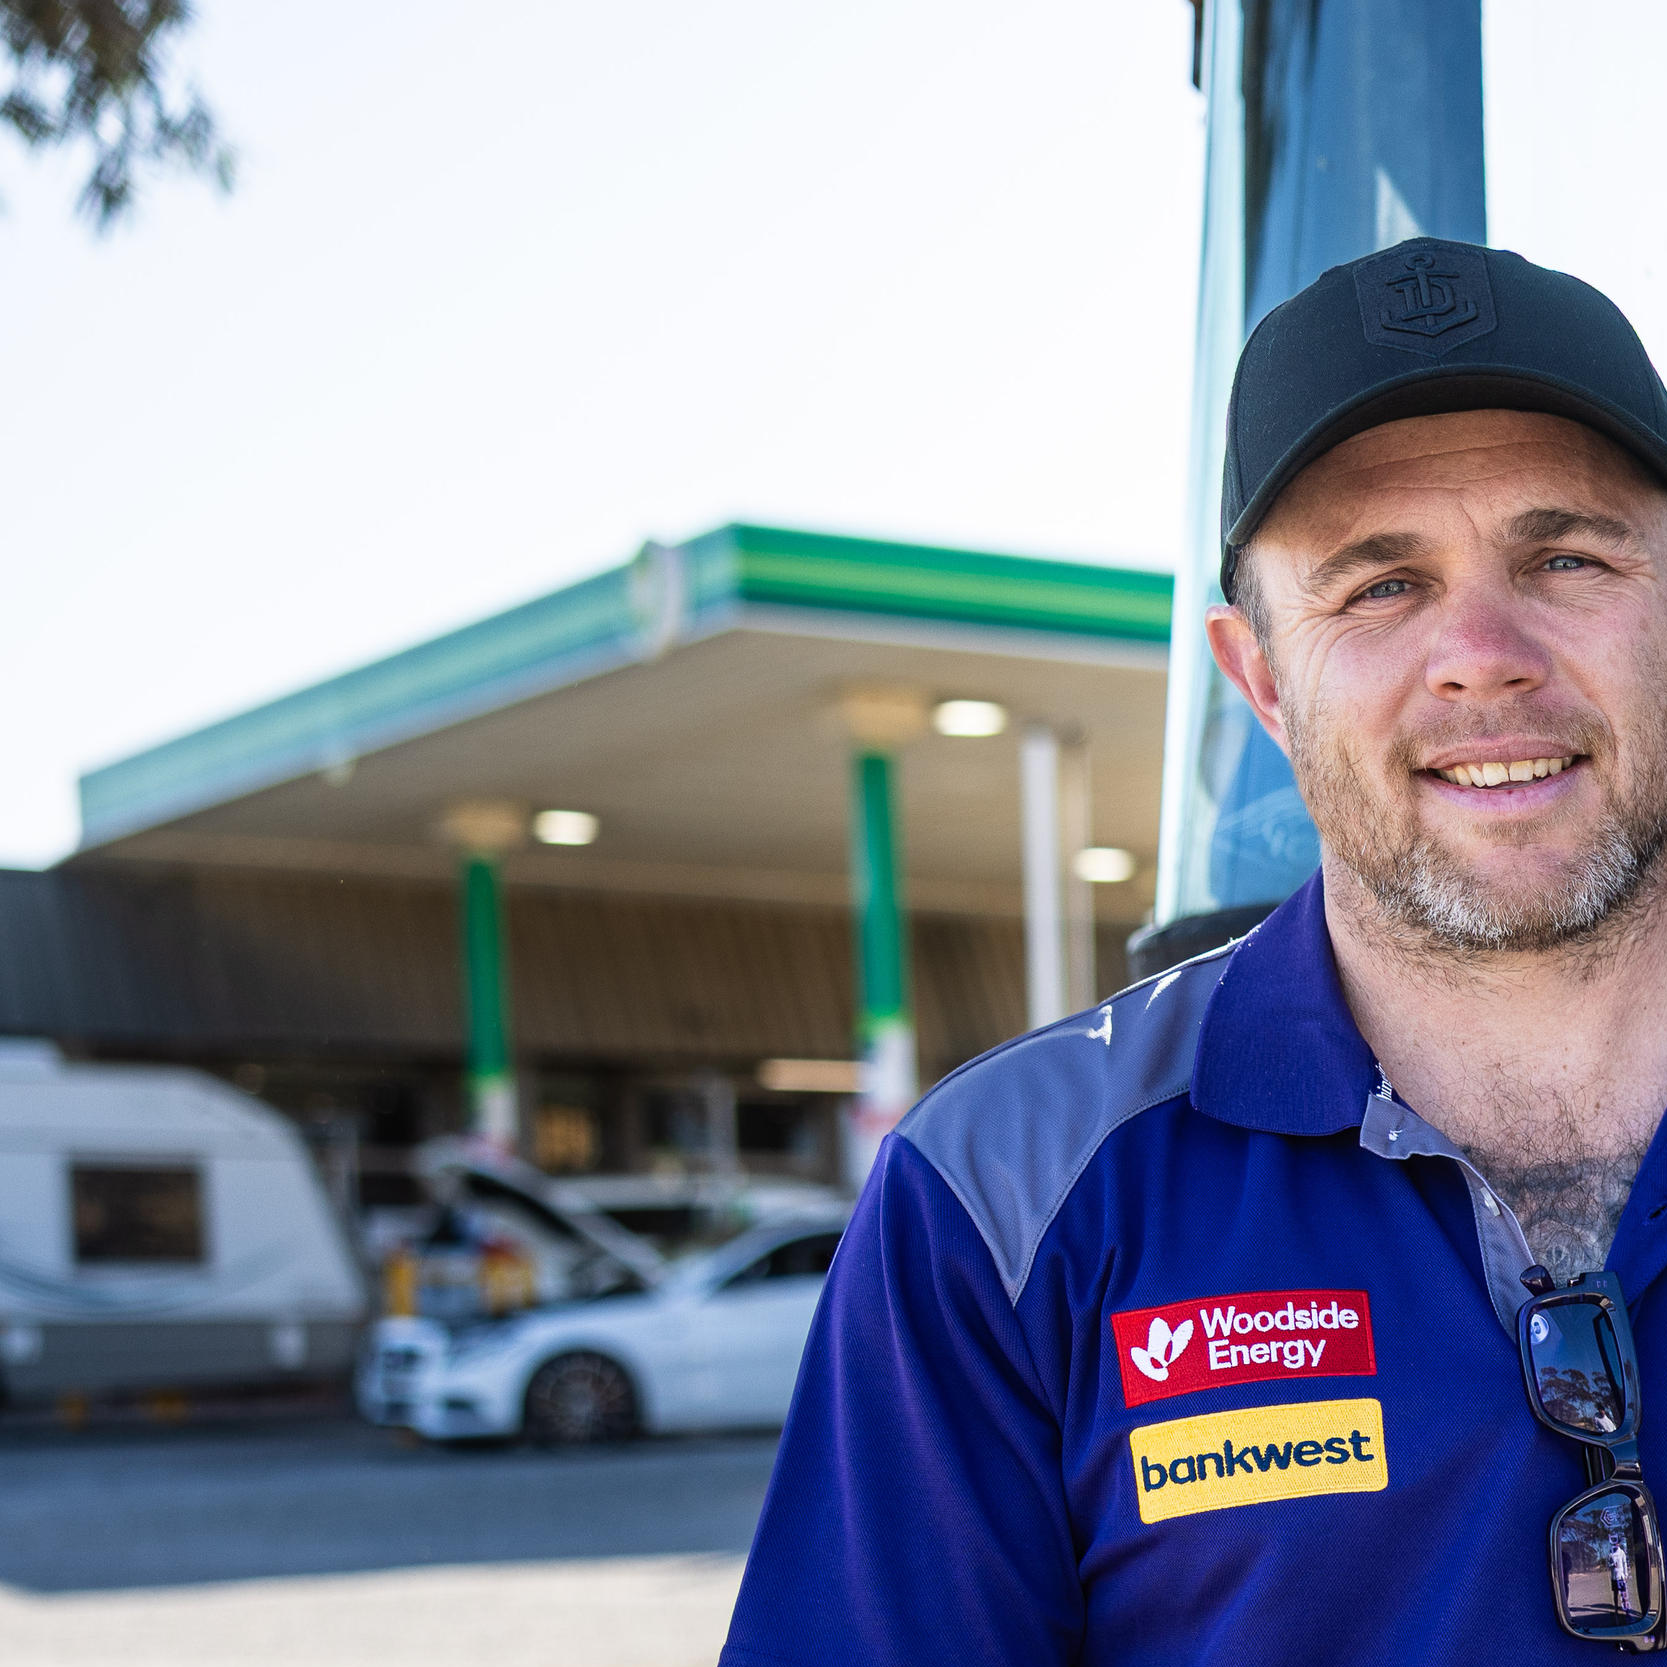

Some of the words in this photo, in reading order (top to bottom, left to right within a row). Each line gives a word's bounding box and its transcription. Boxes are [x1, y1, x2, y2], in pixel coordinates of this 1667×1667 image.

[1200, 1301, 1359, 1339] Woodside
[1208, 1338, 1326, 1371] Energy
[1141, 1429, 1374, 1492] bankwest
